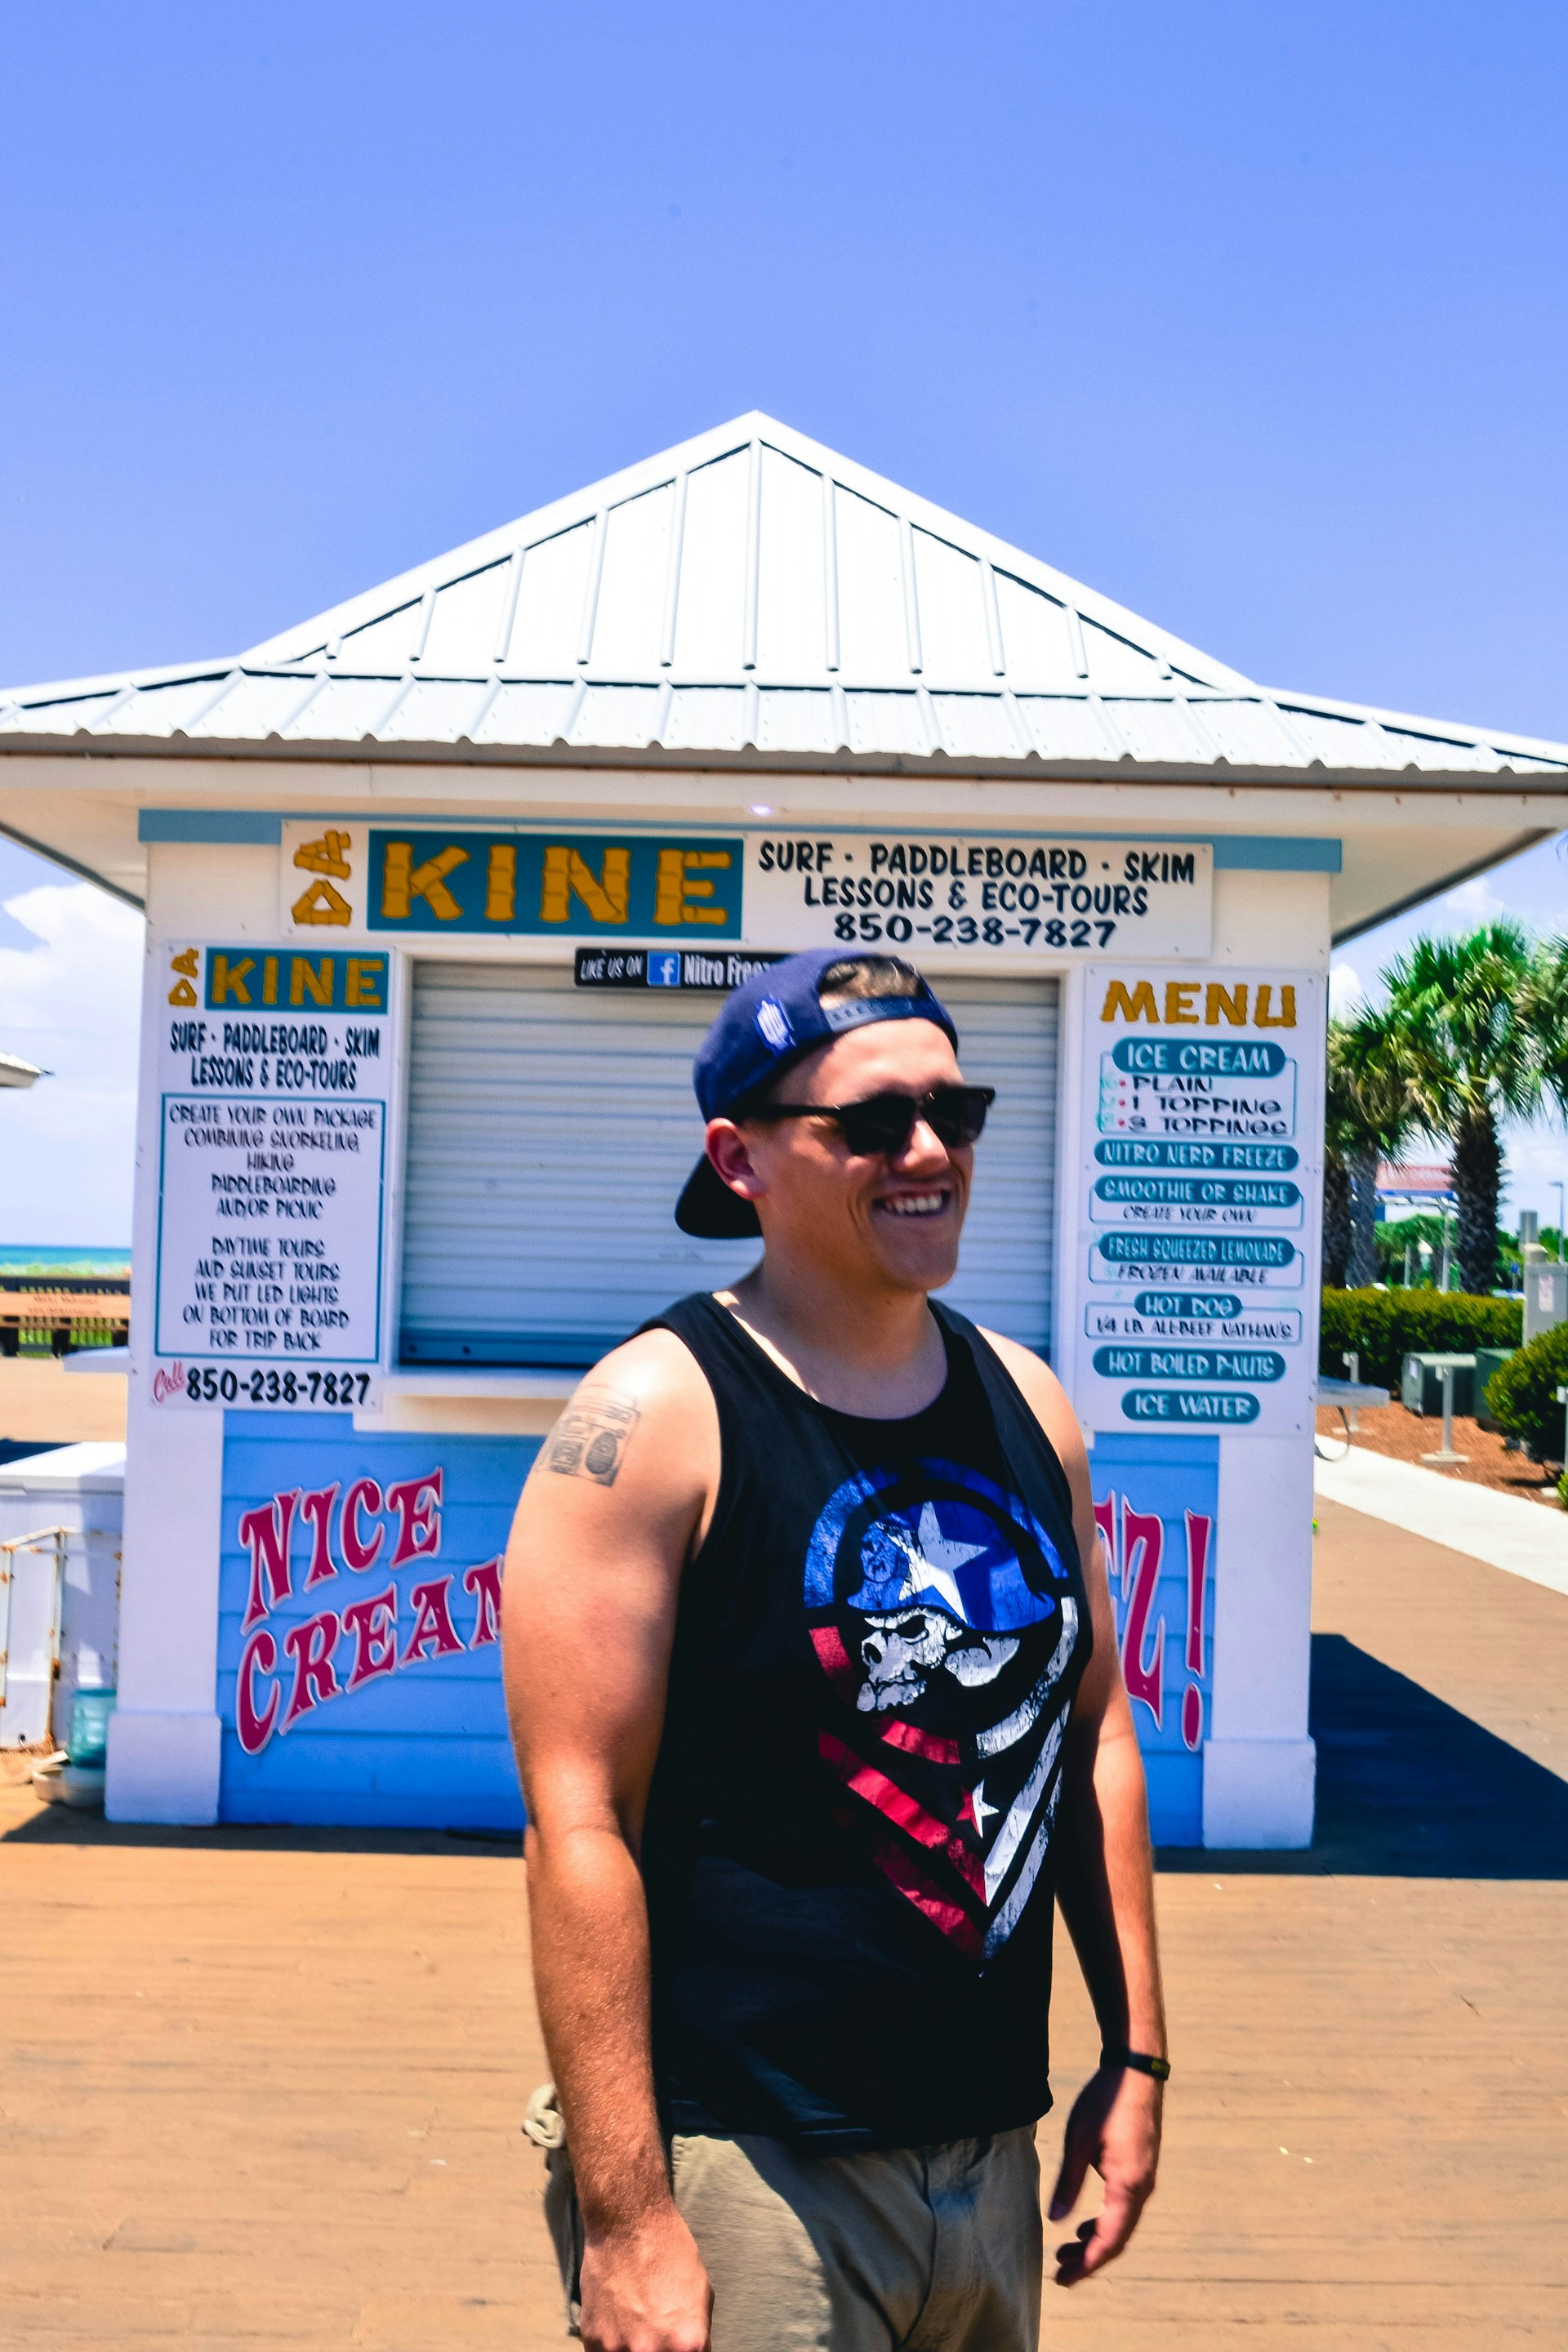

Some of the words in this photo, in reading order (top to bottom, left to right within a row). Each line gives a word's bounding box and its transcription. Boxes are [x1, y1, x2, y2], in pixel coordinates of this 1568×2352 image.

[759, 840, 834, 874] SURF
[870, 843, 1087, 880] PADDLEBOARD
[1124, 851, 1195, 885] SKIM
[380, 840, 733, 925] KINE
[804, 875, 934, 910] LESSONS
[947, 880, 968, 911] &
[982, 881, 1149, 916] ECO-TOURS
[833, 913, 1117, 949] 850-238-7827
[212, 955, 384, 1006] KINE
[581, 957, 605, 981] LIKE
[607, 956, 624, 979] US
[626, 955, 643, 978] ON
[684, 954, 724, 987] Nitro
[1100, 980, 1297, 1028] MENU
[170, 1020, 207, 1053] SURF
[223, 1022, 327, 1056] PADDLEBOARD
[345, 1026, 381, 1058] SKIM
[1127, 1042, 1168, 1070] ICE
[1179, 1045, 1271, 1073] CREAM
[190, 1054, 253, 1088] LESSONS
[259, 1059, 270, 1088] &
[276, 1058, 357, 1091] ECO-TOURS
[1132, 1074, 1214, 1092] PLAIN
[169, 1103, 220, 1125] CREATE
[226, 1105, 267, 1126] YOUR
[272, 1106, 307, 1127] OWN
[314, 1107, 376, 1129] PACKAGE
[1132, 1094, 1139, 1111] 1
[1156, 1095, 1282, 1116] TOPPING
[184, 1126, 263, 1147] COMBINING
[1160, 1115, 1288, 1136] TOPPINGS
[1103, 1143, 1160, 1165] NITRO
[1166, 1143, 1216, 1167] NERD
[1223, 1145, 1288, 1170] FREEZE
[211, 1173, 336, 1197] PADDLEBOARDING
[1104, 1179, 1195, 1202] SMOOTHIE
[1201, 1182, 1227, 1203] OR
[1232, 1183, 1290, 1205] SHAKE
[276, 1197, 323, 1220] PICNIC
[1122, 1205, 1173, 1221] CREATE
[1179, 1206, 1217, 1223] YOUR
[1222, 1207, 1257, 1223] OWN
[212, 1236, 270, 1258] DAYTIME
[278, 1237, 326, 1258] TOURS
[1108, 1236, 1148, 1259] FRESH
[1152, 1237, 1218, 1262] SQUEEZED
[1222, 1239, 1285, 1264] LEMONADE
[195, 1258, 225, 1278] AND
[229, 1259, 285, 1280] SUNSET
[292, 1262, 340, 1282] TOURS
[1188, 1266, 1268, 1285] AVAILABLE
[194, 1281, 216, 1302] WE
[223, 1282, 252, 1303] PUT
[257, 1284, 283, 1304] LED
[289, 1285, 339, 1305] LIGHTS
[1143, 1294, 1183, 1316] HOT
[1191, 1295, 1233, 1318] DOG
[182, 1304, 203, 1325] ON
[210, 1305, 270, 1326] BOTTOM
[274, 1307, 292, 1327] OF
[301, 1308, 350, 1330] BOARD
[210, 1329, 238, 1348] FOR
[244, 1330, 277, 1350] TRIP
[283, 1331, 323, 1352] BACK
[1222, 1321, 1292, 1340] NATHAN'S
[1108, 1350, 1145, 1374] HOT
[1151, 1351, 1209, 1377] BOILED
[1216, 1352, 1276, 1379] P-NUTS
[153, 1360, 186, 1405] Call
[186, 1366, 372, 1406] 850-238-7827
[1135, 1392, 1171, 1416] ICE
[1179, 1394, 1254, 1419] WATER
[238, 1466, 443, 1637] NICE
